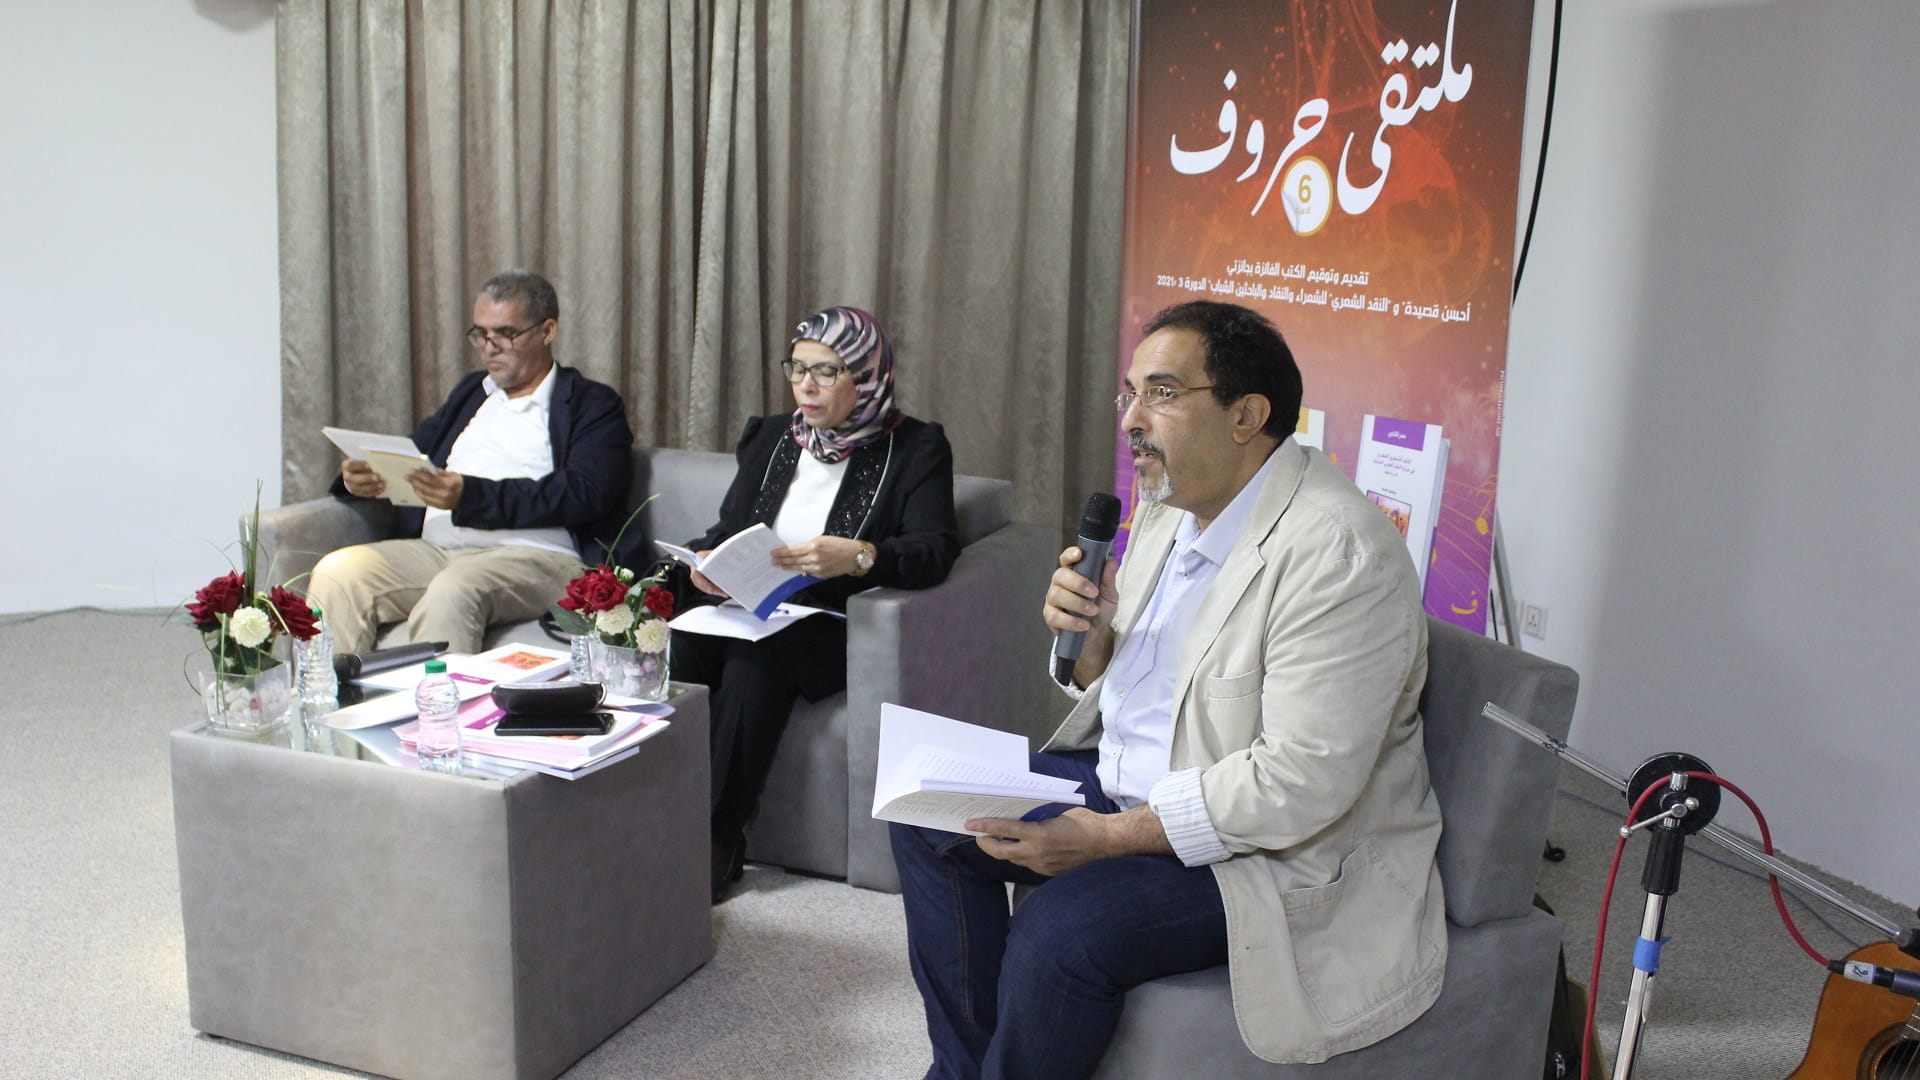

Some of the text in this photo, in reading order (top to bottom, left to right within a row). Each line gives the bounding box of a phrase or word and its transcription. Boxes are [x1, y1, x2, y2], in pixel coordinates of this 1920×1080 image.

[1170, 0, 1473, 216] ملتقى حروف
[1298, 174, 1312, 204] 6
[1254, 261, 1281, 277] الفائزة
[1281, 264, 1306, 280] الكتب
[1178, 276, 1183, 288] 3
[1184, 277, 1207, 292] الدورة
[1341, 271, 1370, 287] تقديم
[1268, 284, 1294, 303] والنقاد
[1392, 303, 1400, 316] و
[1441, 301, 1471, 322] أحسن
